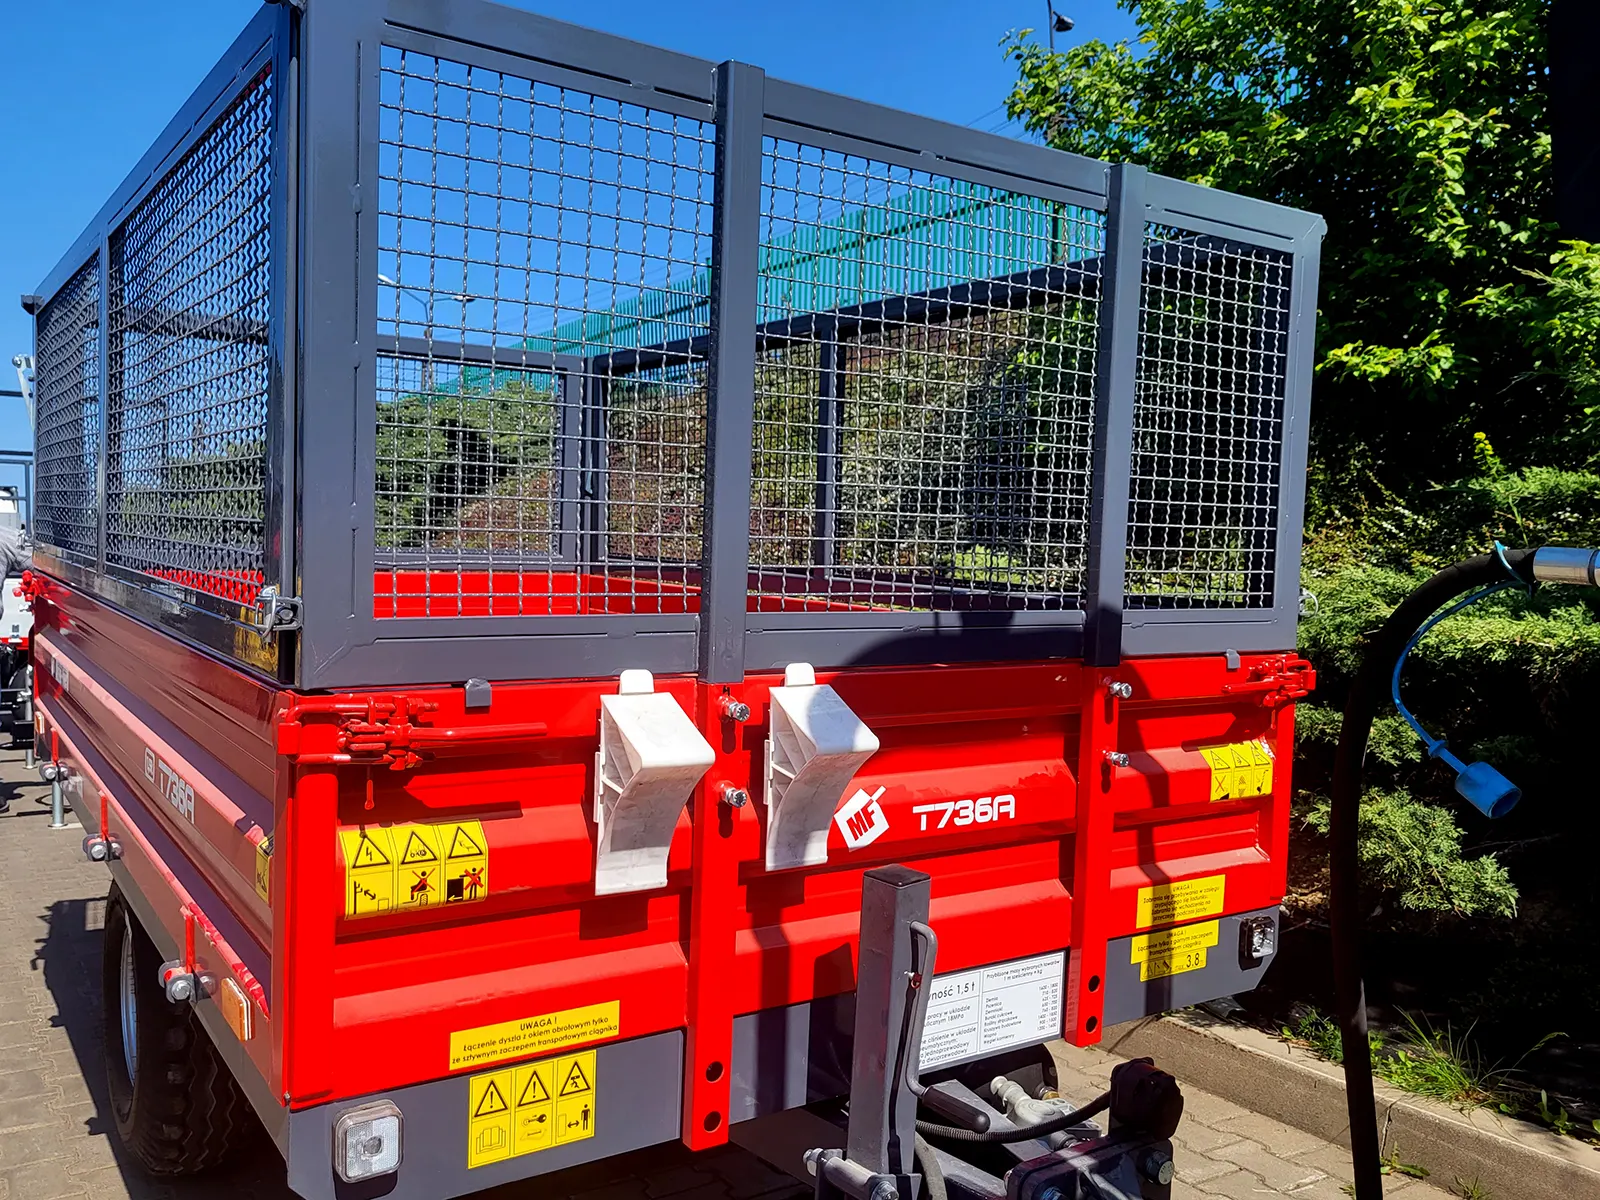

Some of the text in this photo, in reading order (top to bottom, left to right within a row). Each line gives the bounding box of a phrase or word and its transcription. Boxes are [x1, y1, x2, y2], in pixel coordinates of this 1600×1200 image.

[158, 758, 195, 824] T736A
[845, 804, 876, 842] MF
[912, 794, 1016, 831] T736A
[1186, 953, 1200, 968] 3.8
[957, 982, 969, 995] 1,5
[972, 981, 975, 991] t
[498, 1033, 521, 1045] dyszla
[523, 1032, 527, 1040] z
[528, 1028, 551, 1039] okiem
[552, 1020, 591, 1035] obrotowym
[592, 1016, 609, 1028] tylko
[520, 1018, 552, 1031] UWAGA
[452, 1024, 618, 1064] ze sztywnym zaczepem transportowym ciągnika
